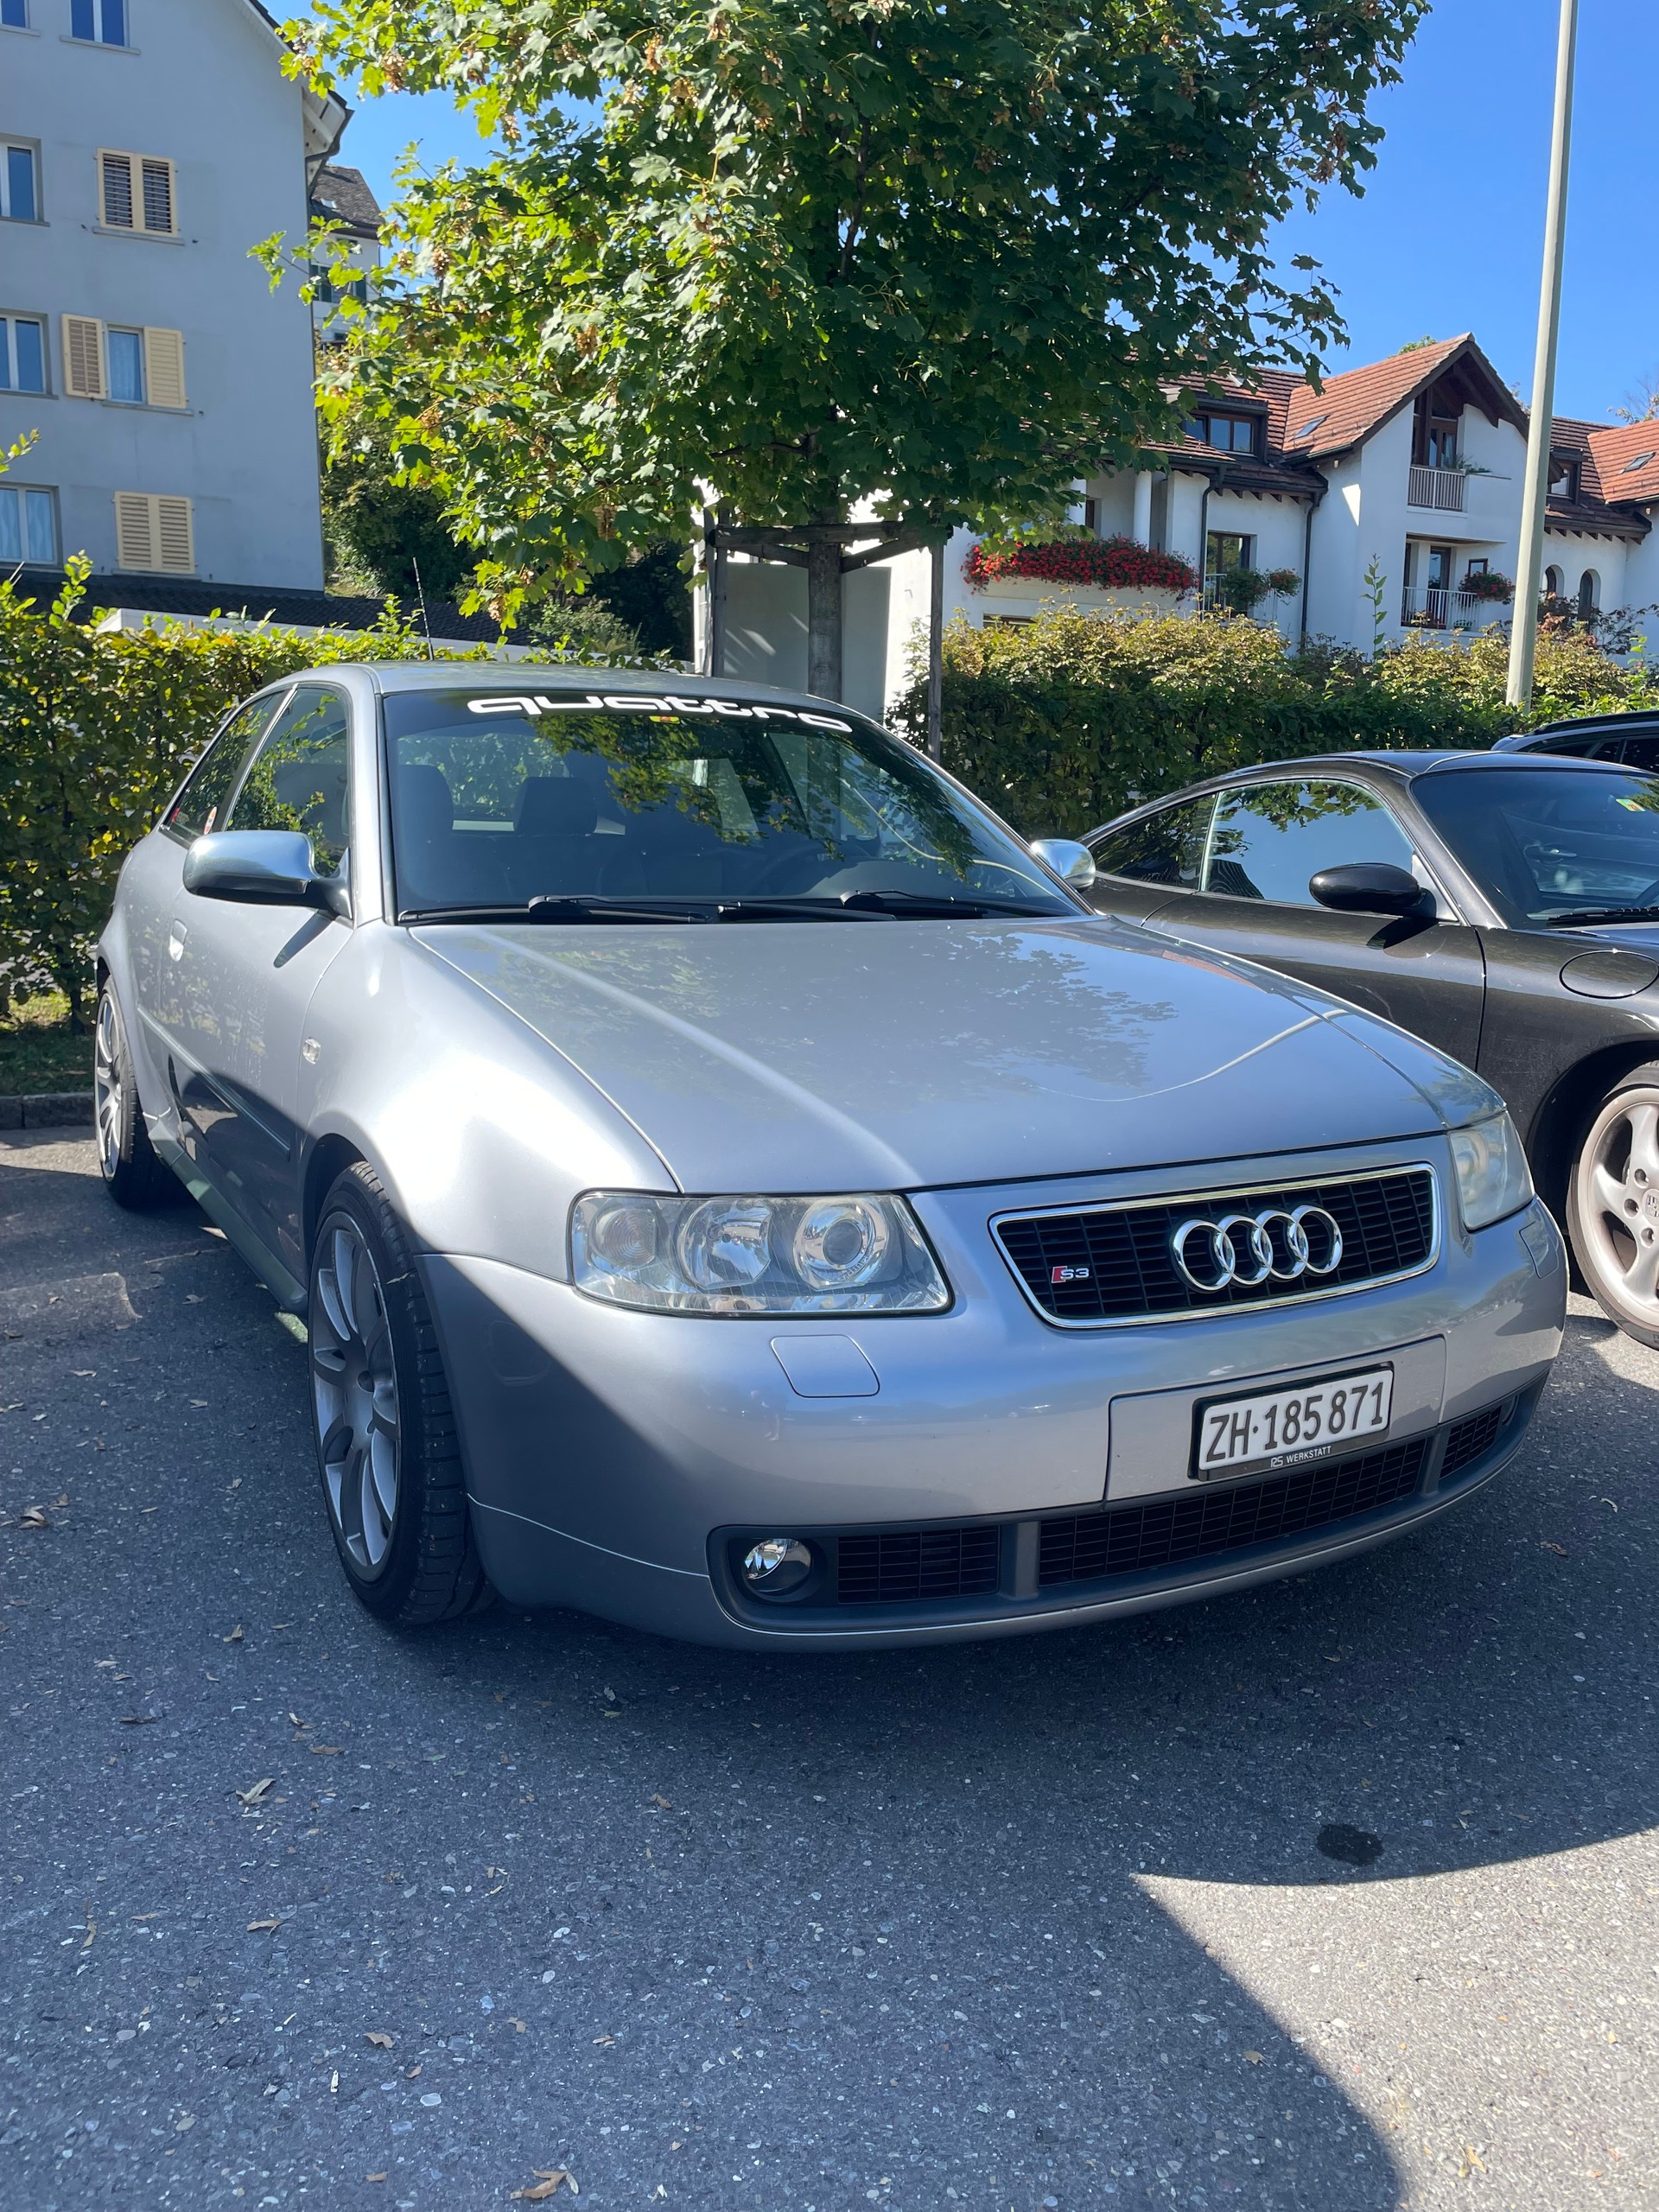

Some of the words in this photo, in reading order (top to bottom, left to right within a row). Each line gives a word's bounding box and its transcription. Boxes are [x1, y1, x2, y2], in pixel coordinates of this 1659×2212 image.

[467, 696, 853, 733] quattro
[1059, 1268, 1090, 1281] S3
[1286, 1446, 1332, 1464] WERKSTATT
